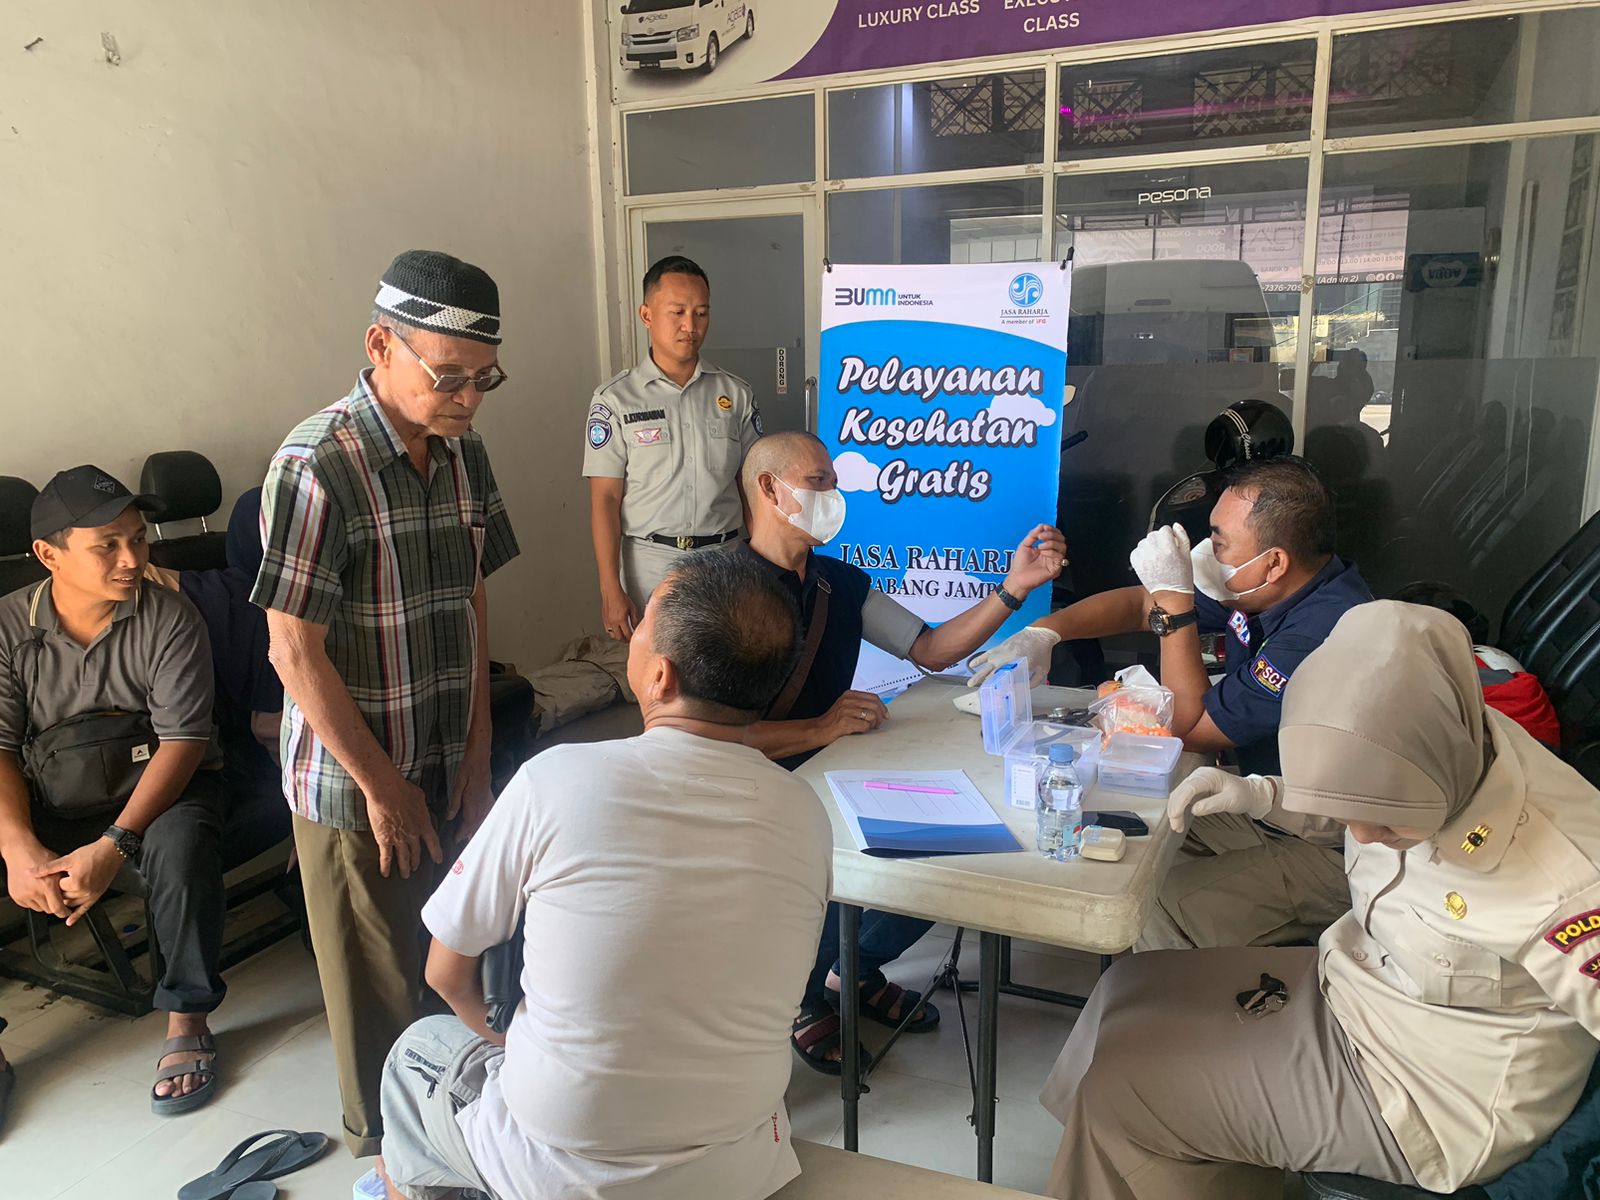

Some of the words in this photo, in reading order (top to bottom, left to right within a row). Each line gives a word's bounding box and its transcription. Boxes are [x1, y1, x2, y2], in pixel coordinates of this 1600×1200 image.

[858, 6, 922, 28] LUXURY
[926, 0, 980, 18] CLASS
[1023, 12, 1080, 33] CLASS
[837, 356, 1042, 401] Pelayanan
[839, 408, 1037, 447] Kesehatan
[878, 458, 991, 503] Gratis
[840, 544, 899, 570] JASA
[907, 547, 1012, 574] RAHARJ
[871, 578, 939, 597] ABANG
[1262, 666, 1287, 689] SCI
